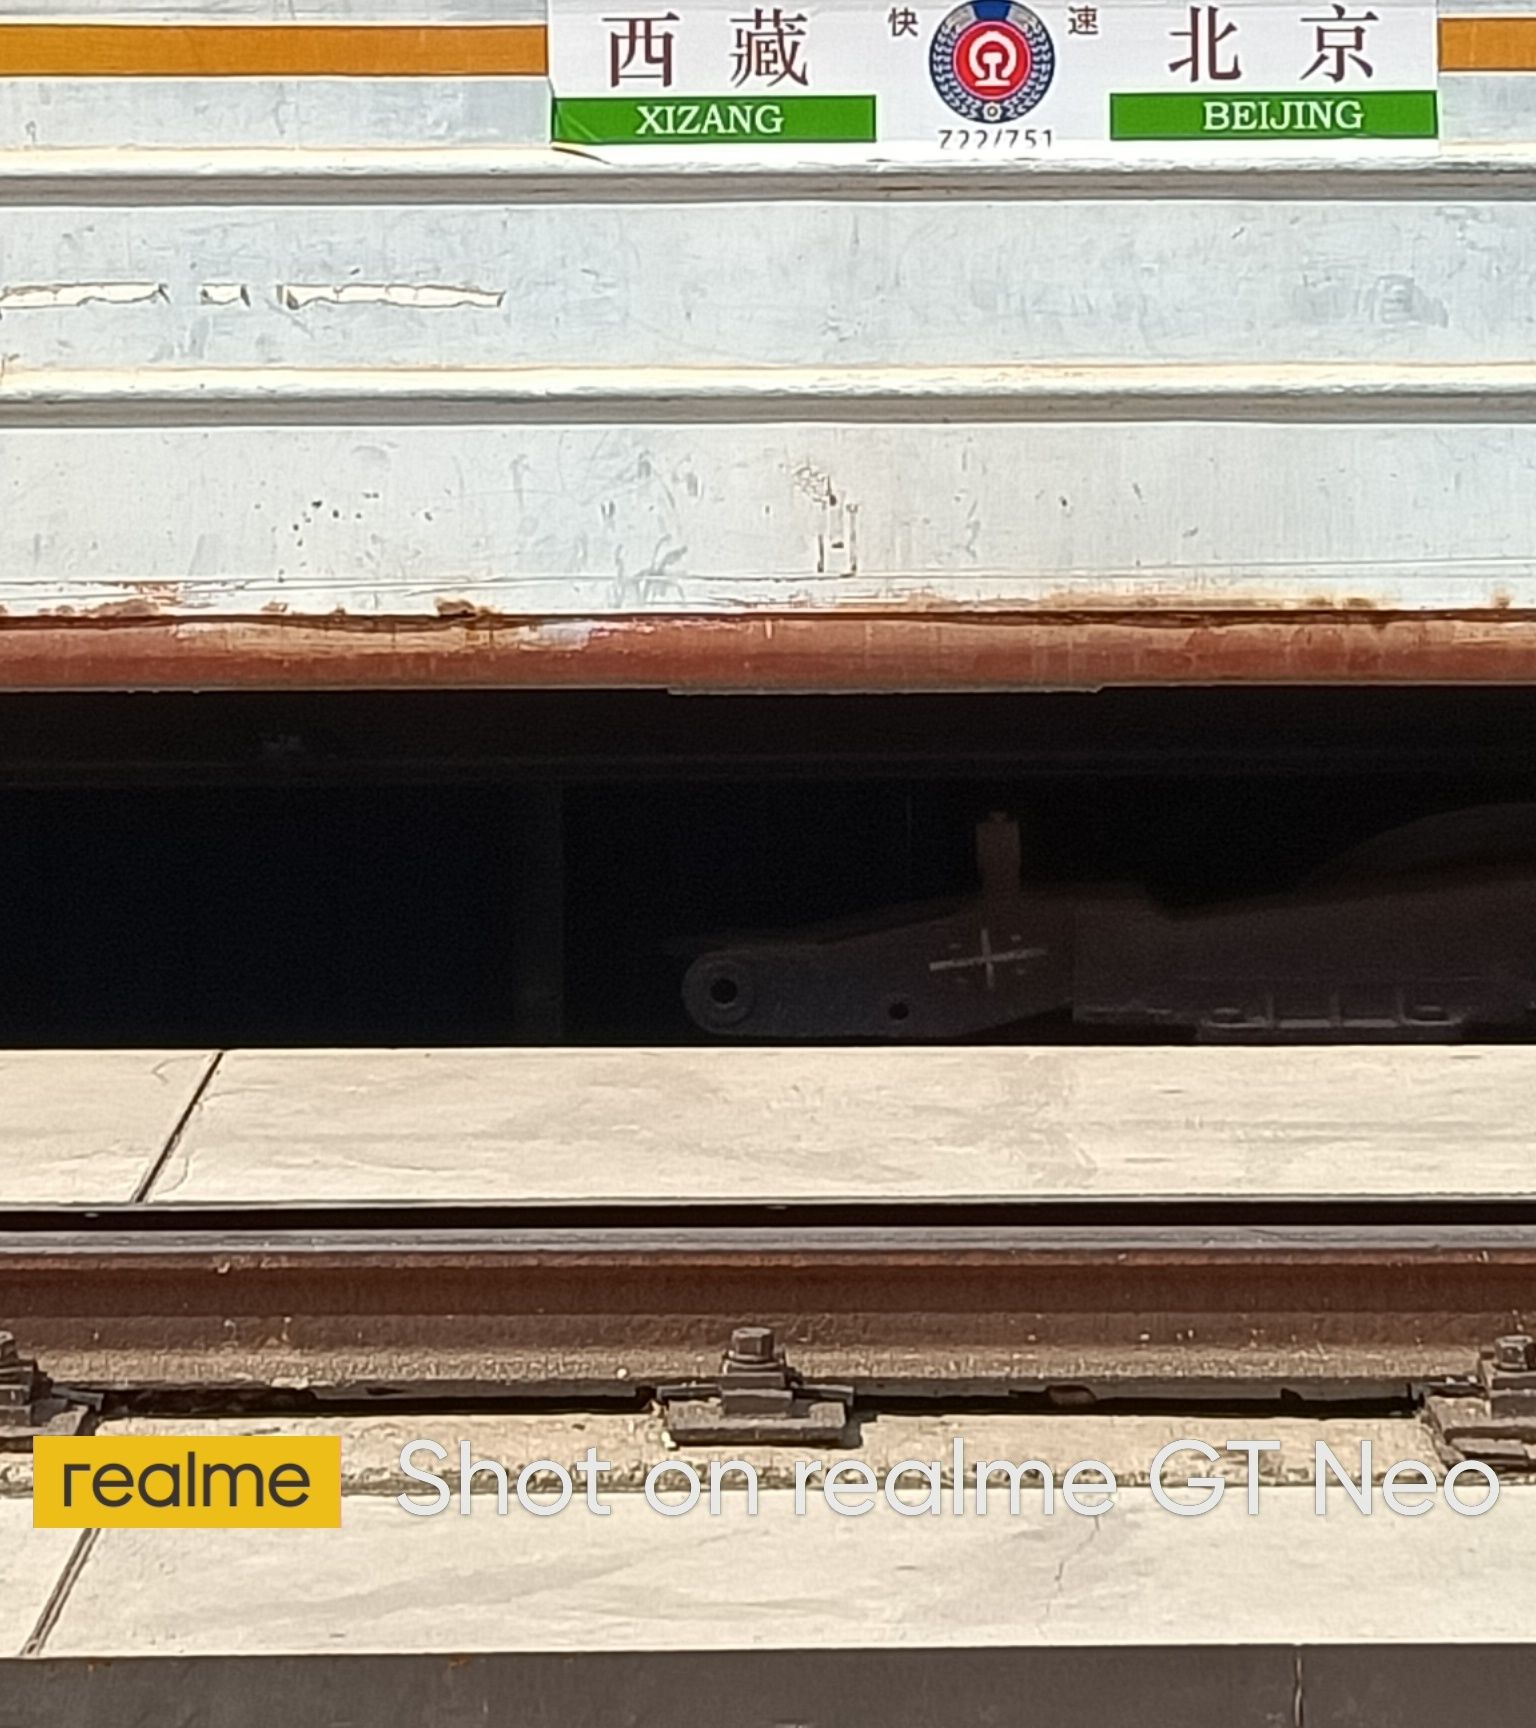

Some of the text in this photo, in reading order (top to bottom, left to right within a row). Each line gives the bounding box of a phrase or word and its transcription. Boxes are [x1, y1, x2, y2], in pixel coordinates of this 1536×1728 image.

[602, 3, 1379, 88] 西藏 快 速 北京
[636, 104, 784, 134] XIZANG
[1203, 100, 1364, 130] BEIJING
